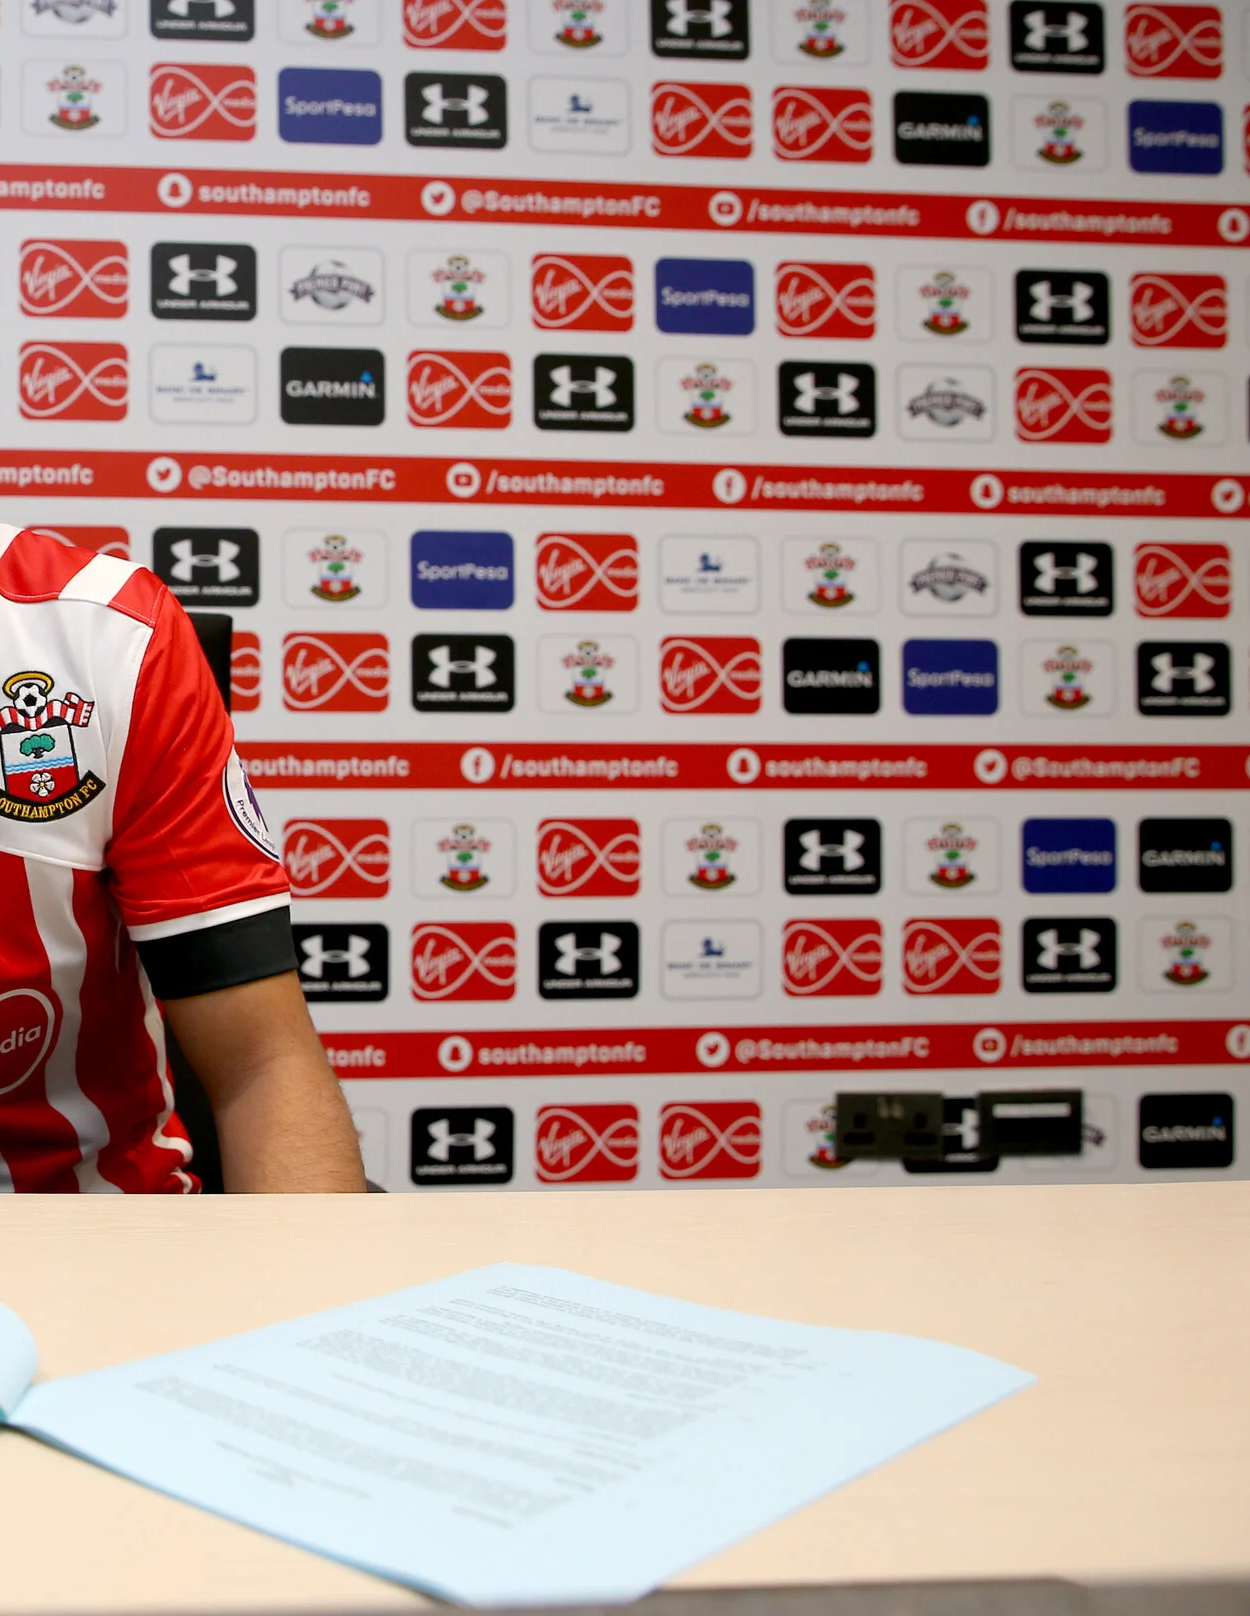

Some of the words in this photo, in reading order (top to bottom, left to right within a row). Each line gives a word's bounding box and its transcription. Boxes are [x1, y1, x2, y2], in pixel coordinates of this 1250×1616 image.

[285, 96, 376, 117] SportPesa
[898, 123, 982, 141] GARMIN
[1134, 127, 1218, 148] SportPesa
[199, 184, 369, 208] southamptonfc
[461, 190, 660, 217] @SouthamptonFC
[661, 287, 749, 307] SportPesa
[286, 380, 375, 398] GARMIN
[188, 465, 395, 492] @SouthamptonFC
[486, 470, 663, 497] /southamptonfc
[417, 561, 508, 581] SportPesa
[787, 669, 872, 687] GARMIN
[907, 668, 994, 688] SportPesa
[500, 754, 678, 780] /southamptonfc
[79, 779, 98, 799] FC
[237, 799, 260, 835] Premier
[1028, 847, 1111, 867] SportPesa
[1143, 849, 1225, 867] GARMIN
[478, 1042, 646, 1066] southamptonfc
[1143, 1124, 1226, 1143] GARMIN
